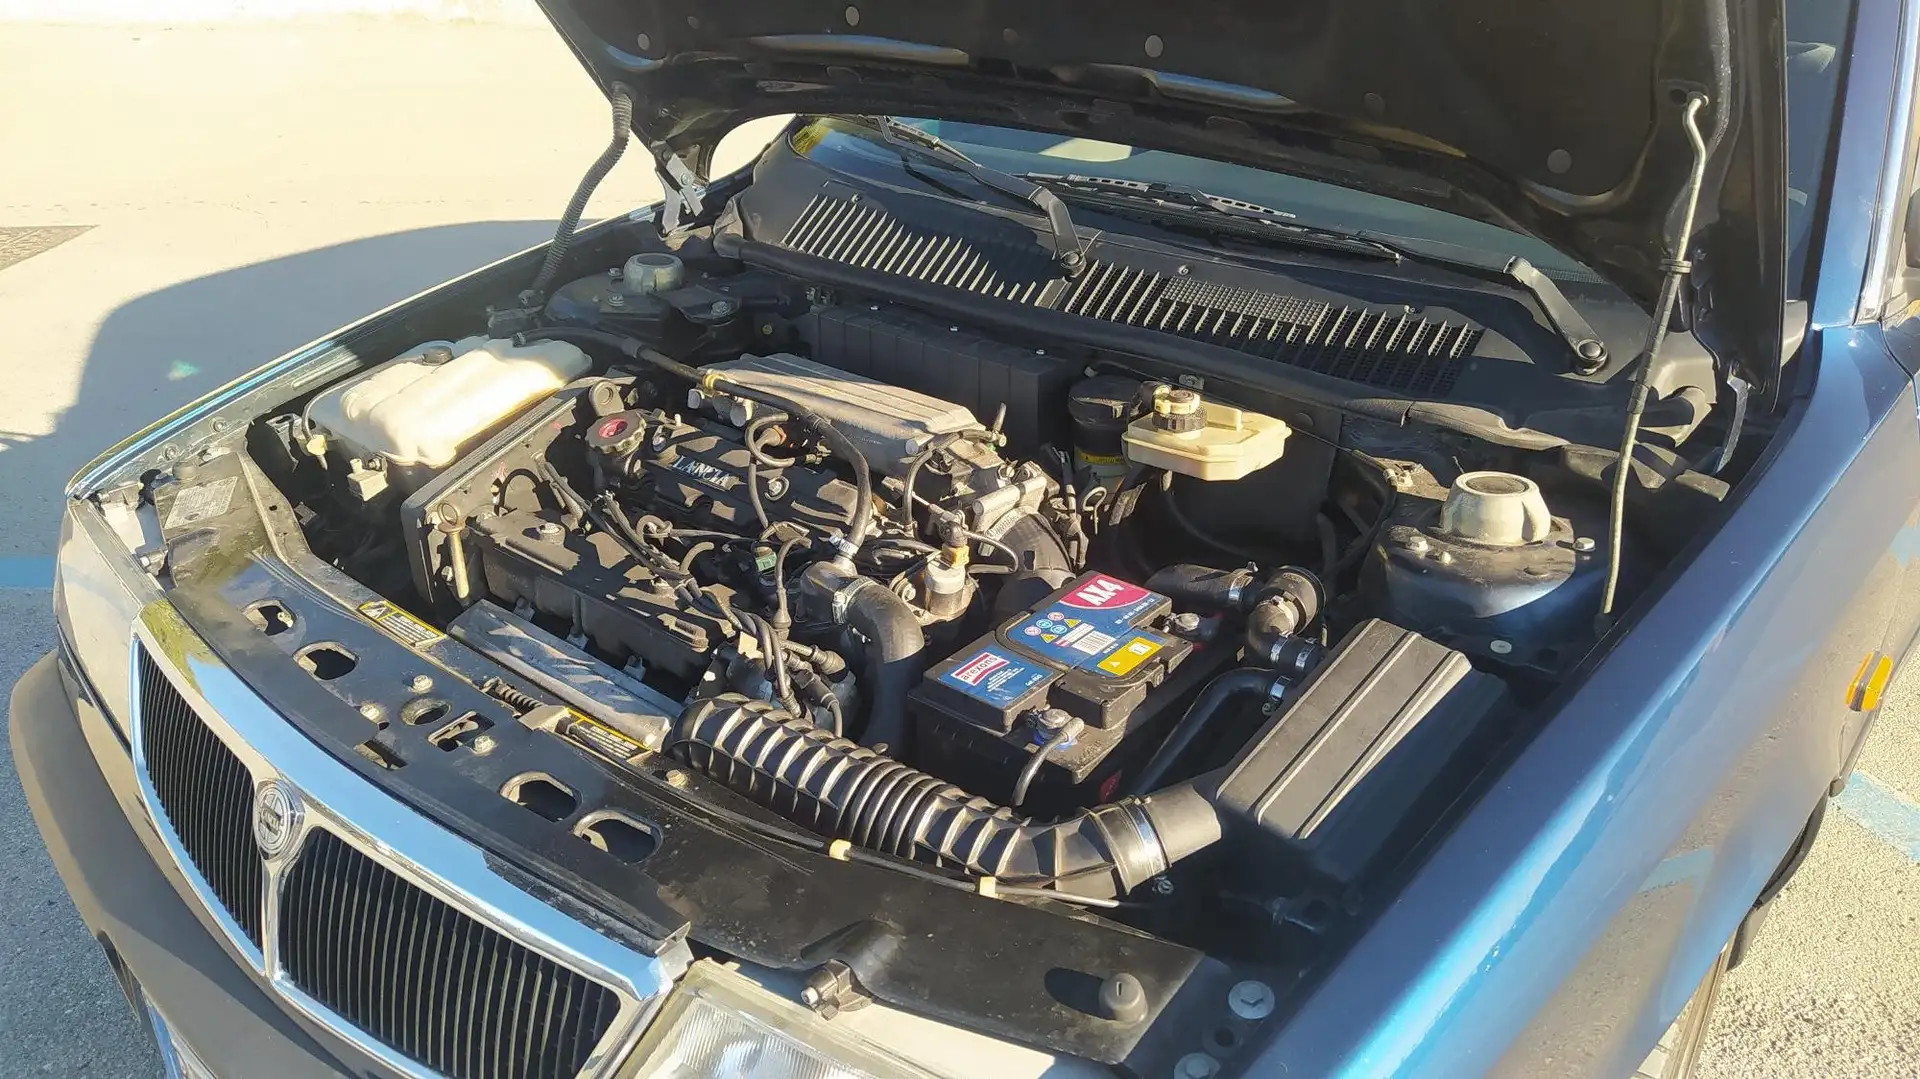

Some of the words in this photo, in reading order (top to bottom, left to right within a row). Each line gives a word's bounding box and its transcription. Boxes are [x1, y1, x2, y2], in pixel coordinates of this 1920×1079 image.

[672, 455, 730, 488] LANCIA
[1076, 579, 1124, 606] AX4
[960, 656, 998, 681] arexons
